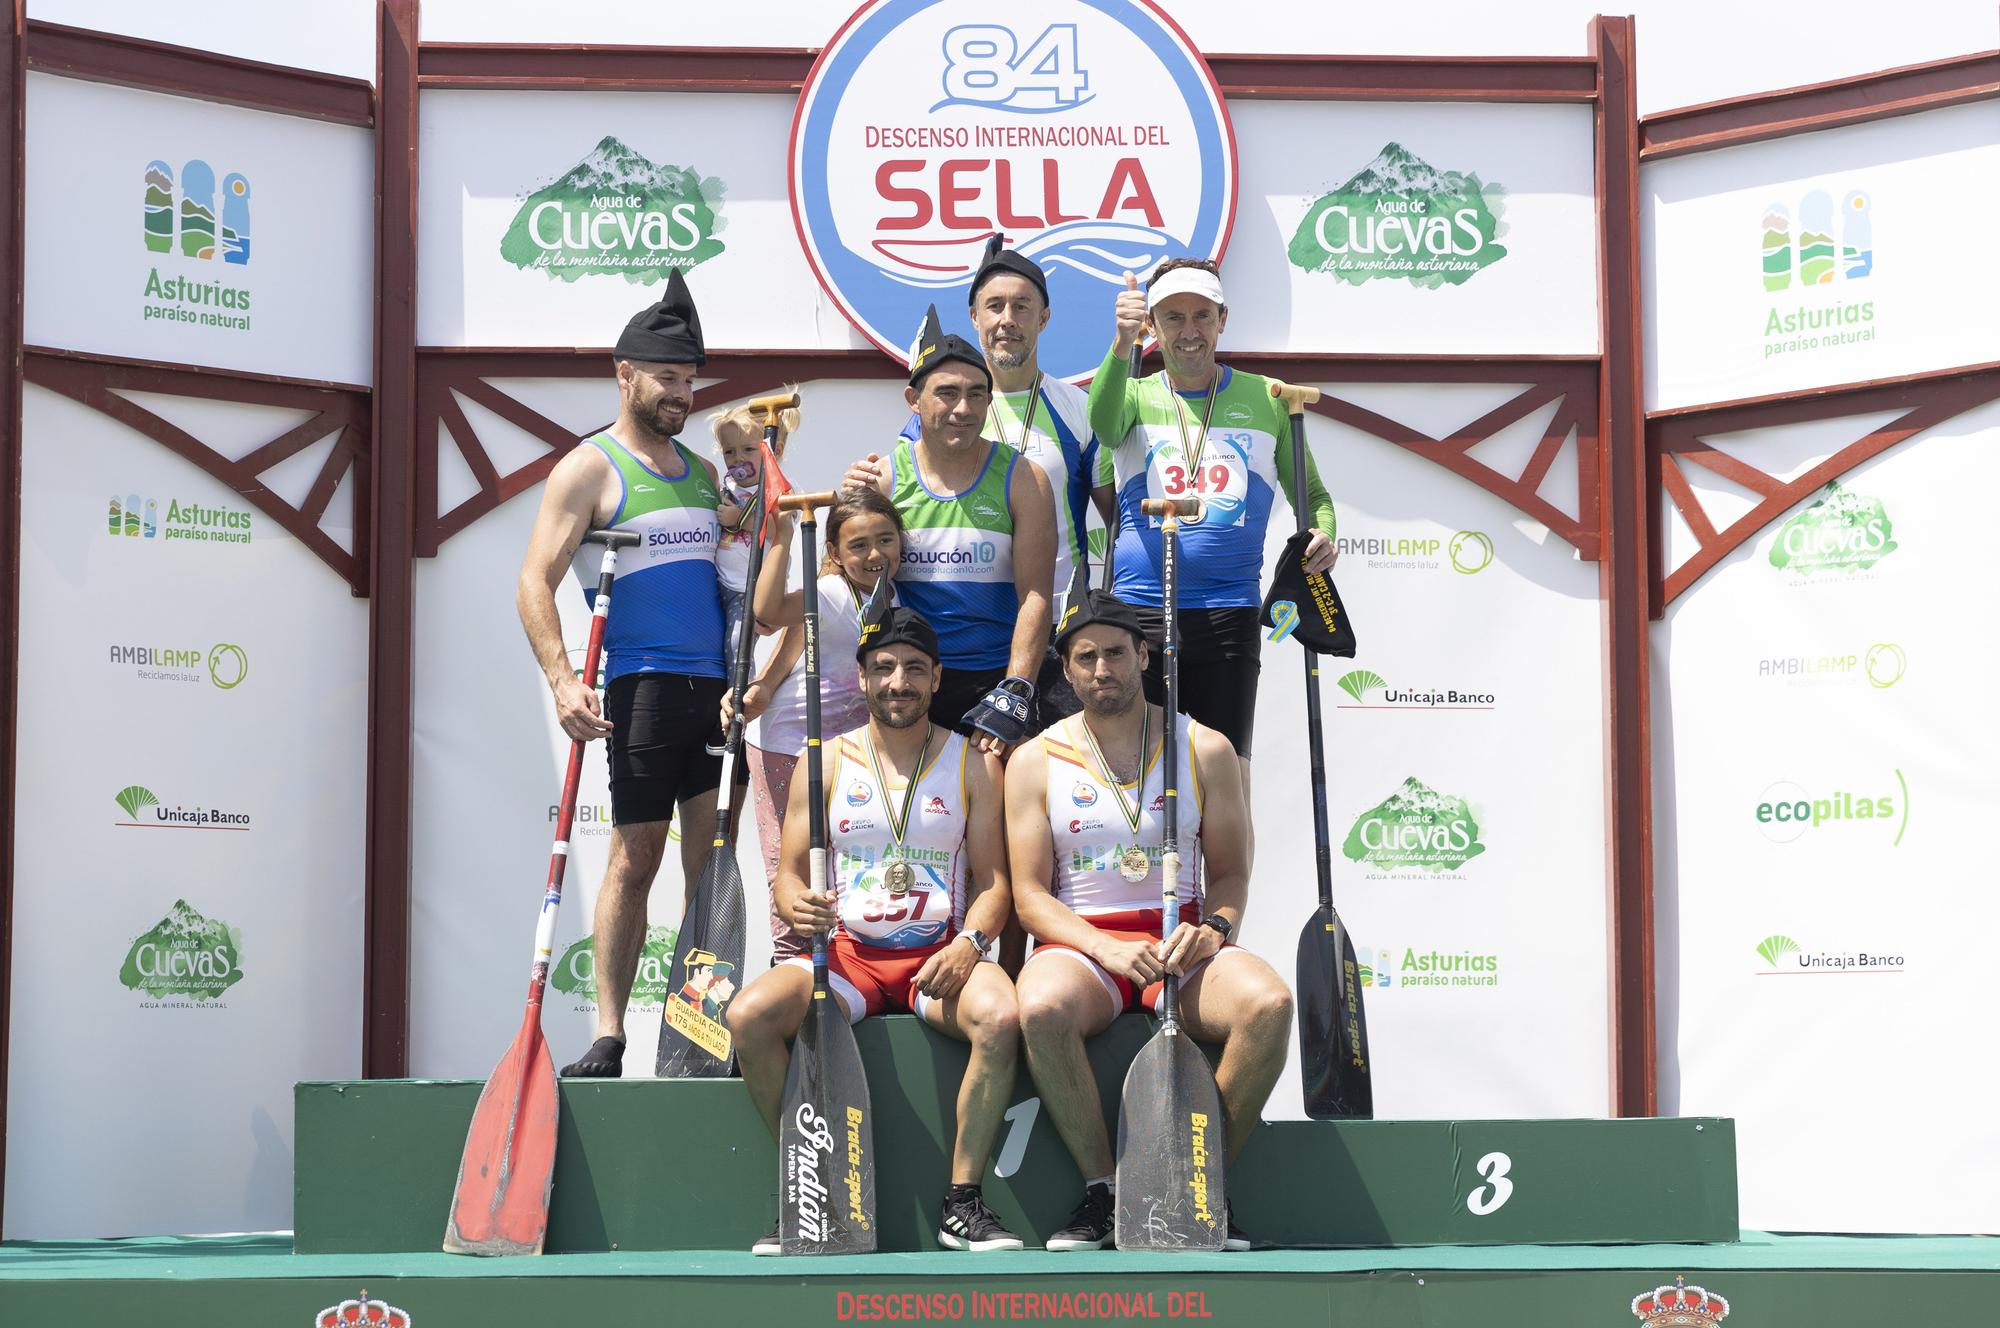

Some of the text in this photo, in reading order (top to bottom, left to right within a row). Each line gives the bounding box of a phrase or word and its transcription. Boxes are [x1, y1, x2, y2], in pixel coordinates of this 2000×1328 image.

[942, 23, 1089, 105] 84
[865, 125, 1170, 148] DESCENSO INTERNACIONAL DEL
[590, 194, 642, 210] Agua de
[875, 157, 1166, 231] SELLA
[1374, 198, 1426, 214] Agua de
[534, 251, 696, 267] de la montaña asturiana
[1321, 255, 1480, 272] de la montaña asturiana
[144, 267, 251, 311] Asturias
[144, 304, 251, 331] paraíso natural
[1764, 300, 1875, 336] Asturias
[1765, 326, 1876, 359] paraíso natural
[1165, 464, 1230, 494] 349
[166, 498, 251, 529] Asturias
[165, 526, 251, 544] paraíso natural
[1165, 537, 1173, 580] TERMAS
[1337, 538, 1440, 557] AMBILAMP
[1368, 559, 1416, 569] Reciclamos
[1165, 584, 1172, 598] DE
[1315, 596, 1333, 625] DESCENSO
[110, 645, 201, 669] AMBILAMP
[1759, 655, 1857, 676] AMBILAMP
[137, 669, 180, 682] Reciclamos
[1385, 688, 1495, 706] Unicaja Banco
[156, 806, 250, 825] Unicaja Banco
[1399, 814, 1432, 825] Agua de
[1756, 791, 1895, 827] ecopilas
[580, 827, 611, 836] Recicla
[882, 843, 950, 863] Asturias
[863, 890, 930, 922] 357
[170, 938, 199, 949] Agua de
[1401, 948, 1498, 972] Asturias
[1799, 952, 1905, 970] Unicaja Banco
[1401, 971, 1498, 988] paraíso natural
[674, 1013, 688, 1029] 175
[675, 1002, 728, 1042] GUARDIA CIVIL
[994, 1097, 1040, 1178] 1
[788, 1143, 796, 1203] TAPERIA BAR
[796, 1102, 834, 1242] Indian
[1467, 1151, 1514, 1215] 3
[836, 1290, 1213, 1321] DESCENSO INTERNACIONAL DEL
